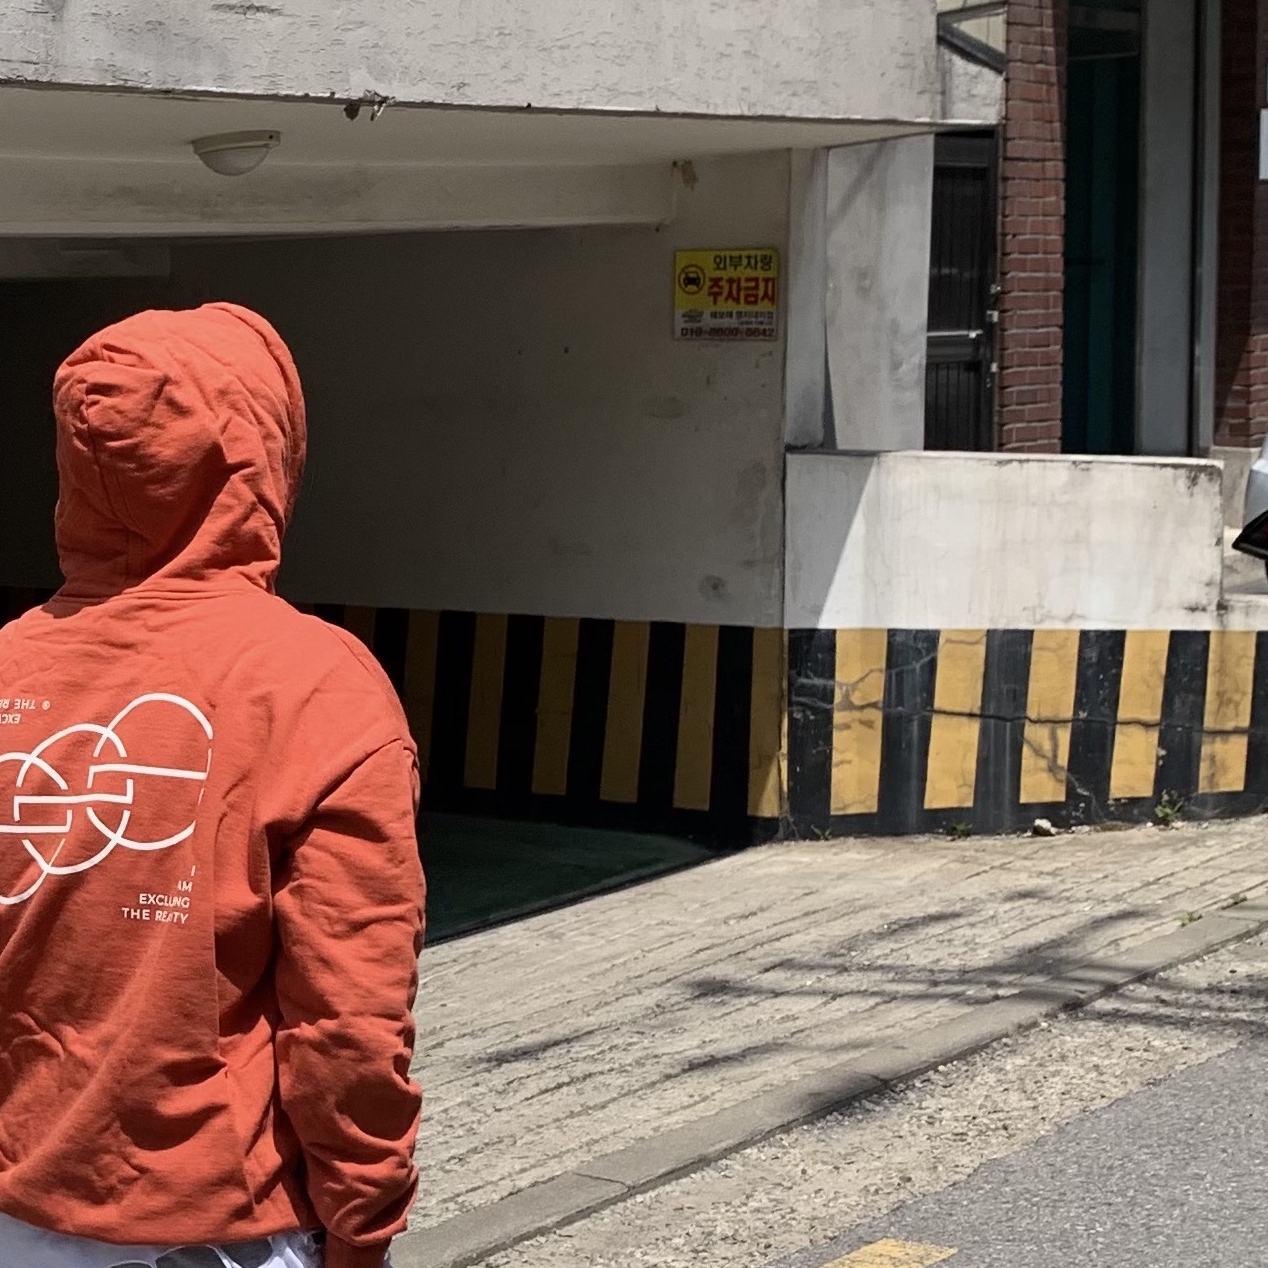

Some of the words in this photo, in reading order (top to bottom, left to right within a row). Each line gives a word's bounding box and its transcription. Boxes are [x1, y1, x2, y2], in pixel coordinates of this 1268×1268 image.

[712, 253, 773, 272] 외부차량
[707, 276, 776, 307] 주차금지
[13, 698, 36, 710] THE
[121, 906, 151, 921] THE
